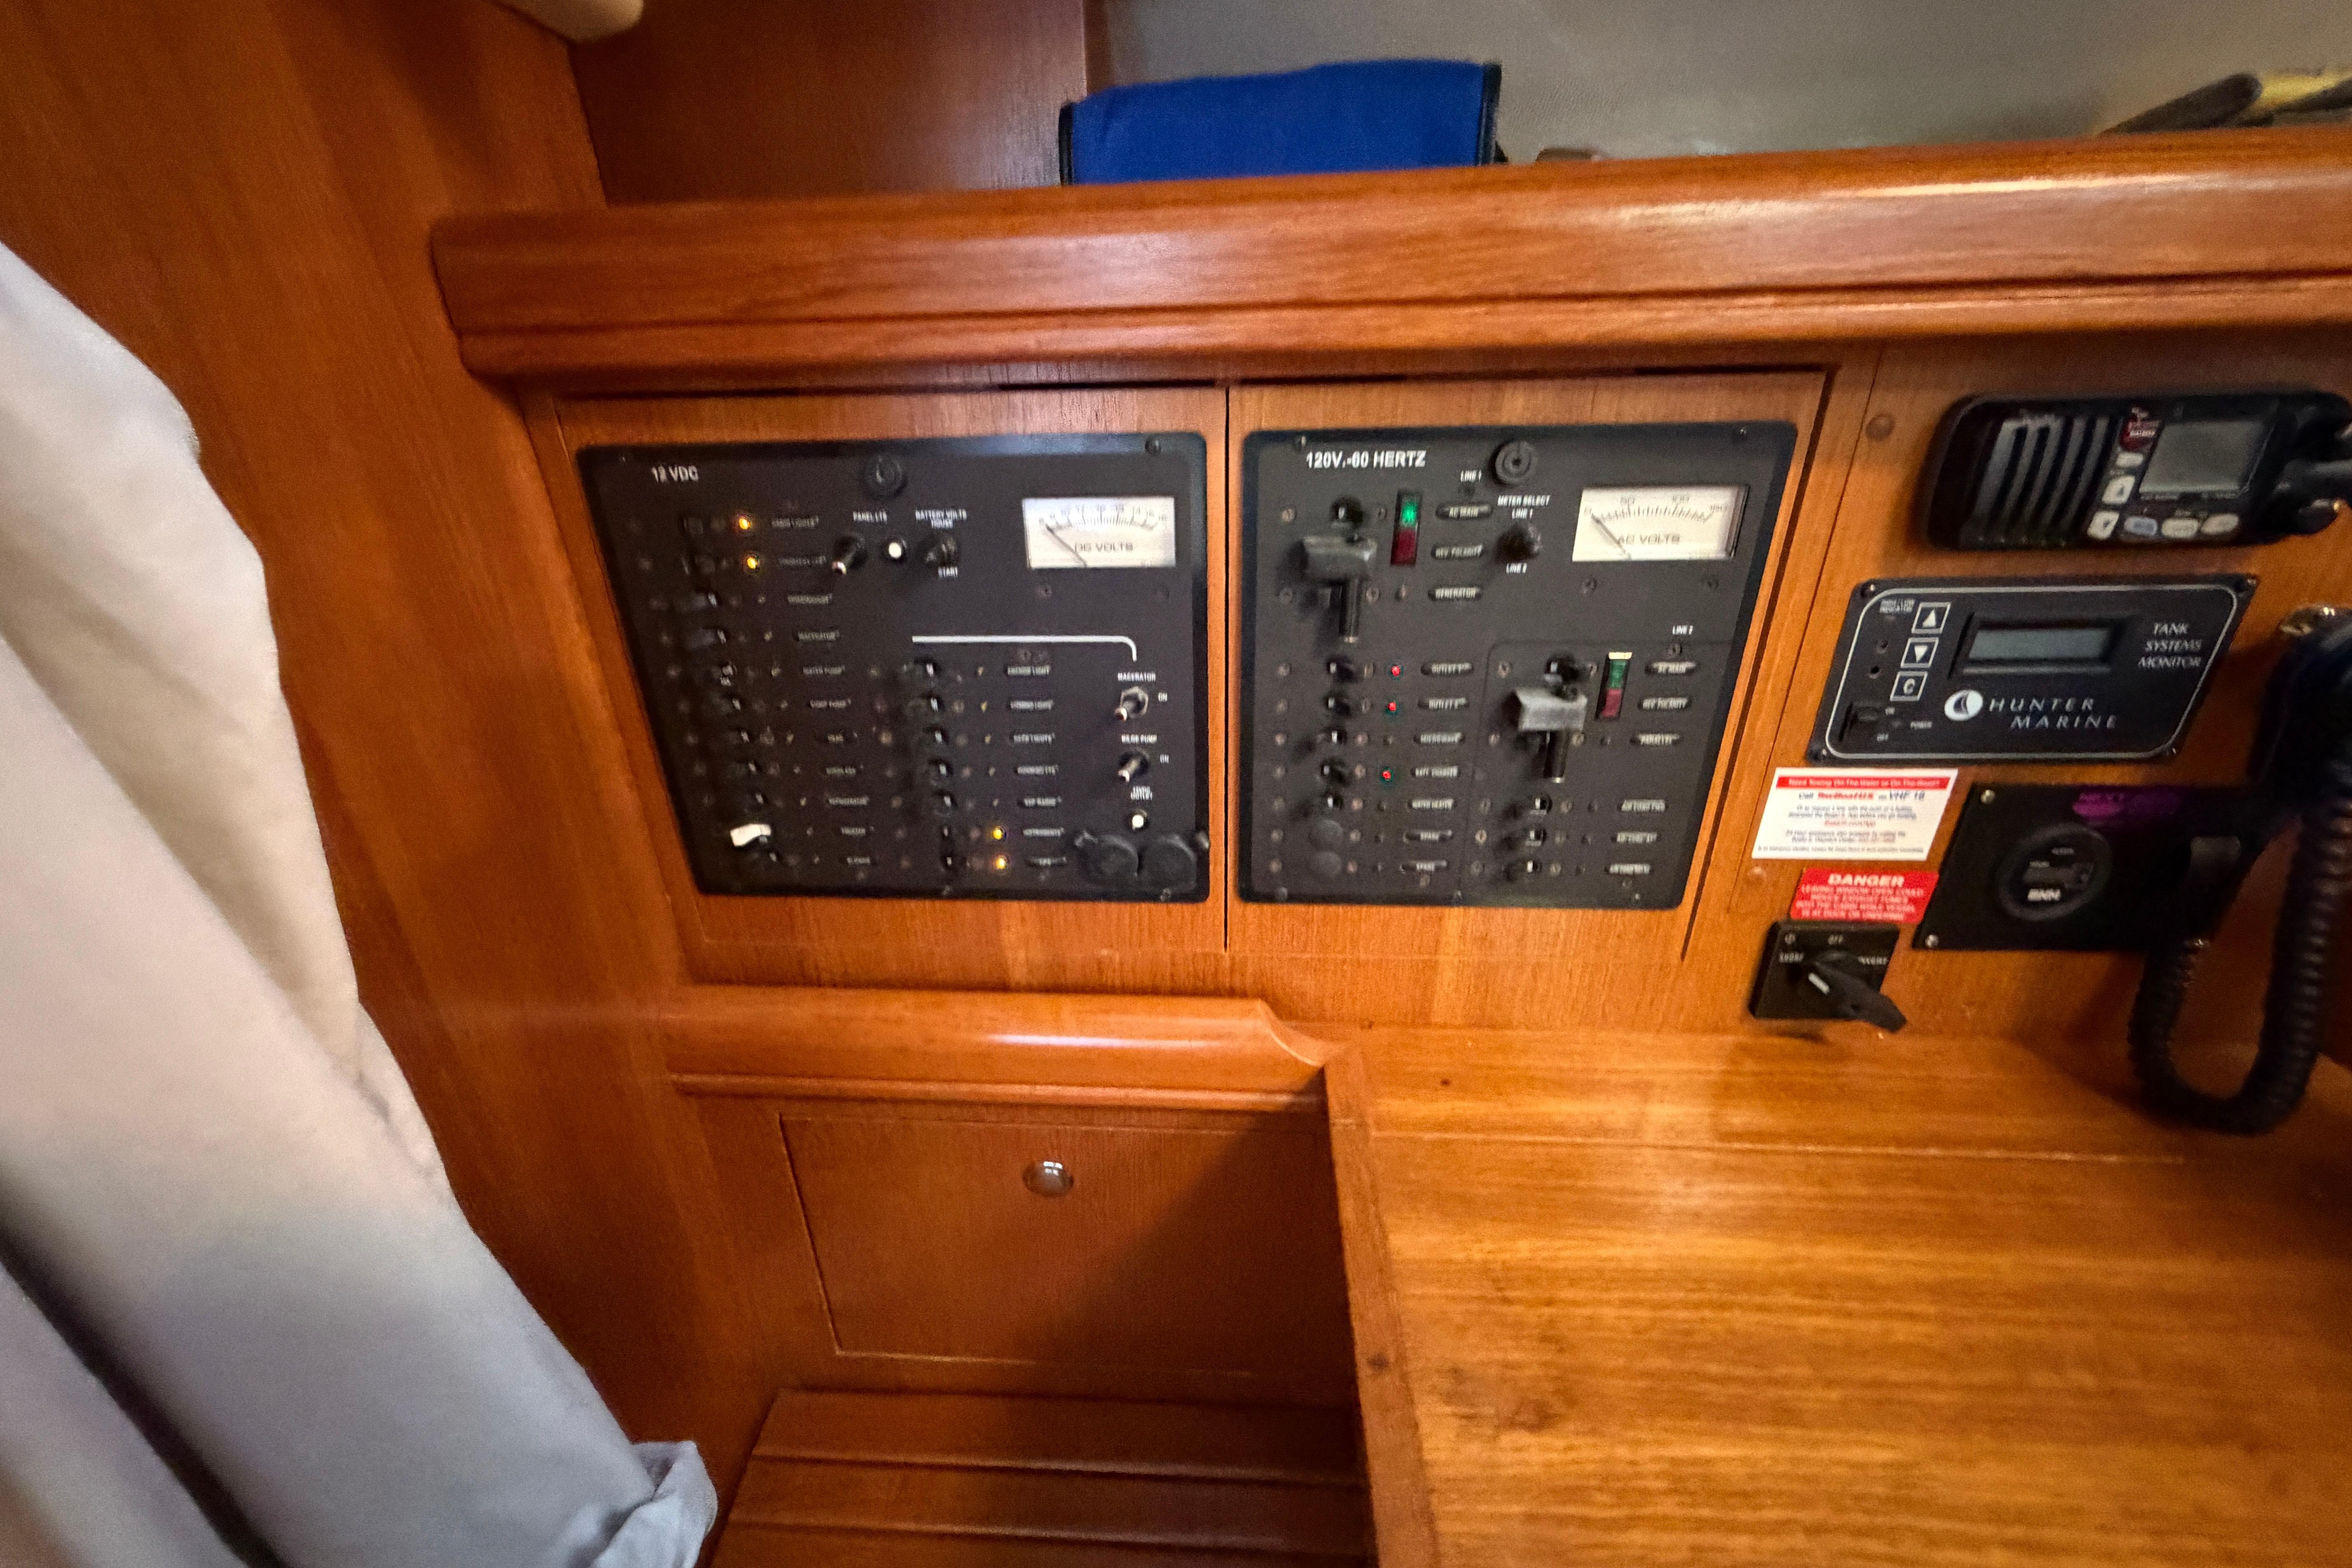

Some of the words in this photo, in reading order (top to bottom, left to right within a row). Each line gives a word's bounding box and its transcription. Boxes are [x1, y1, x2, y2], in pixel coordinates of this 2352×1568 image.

[1373, 450, 1426, 468] HERTZ
[1640, 534, 1680, 545] VOLTS
[1096, 542, 1133, 553] VOLTS
[2154, 623, 2189, 635] TANK
[2145, 639, 2202, 652] SYSTEMS
[2138, 656, 2201, 669] MONITOR
[1989, 698, 2093, 712] HUNTER
[2010, 715, 2116, 728] MARINE
[1827, 873, 1905, 887] DANGER
